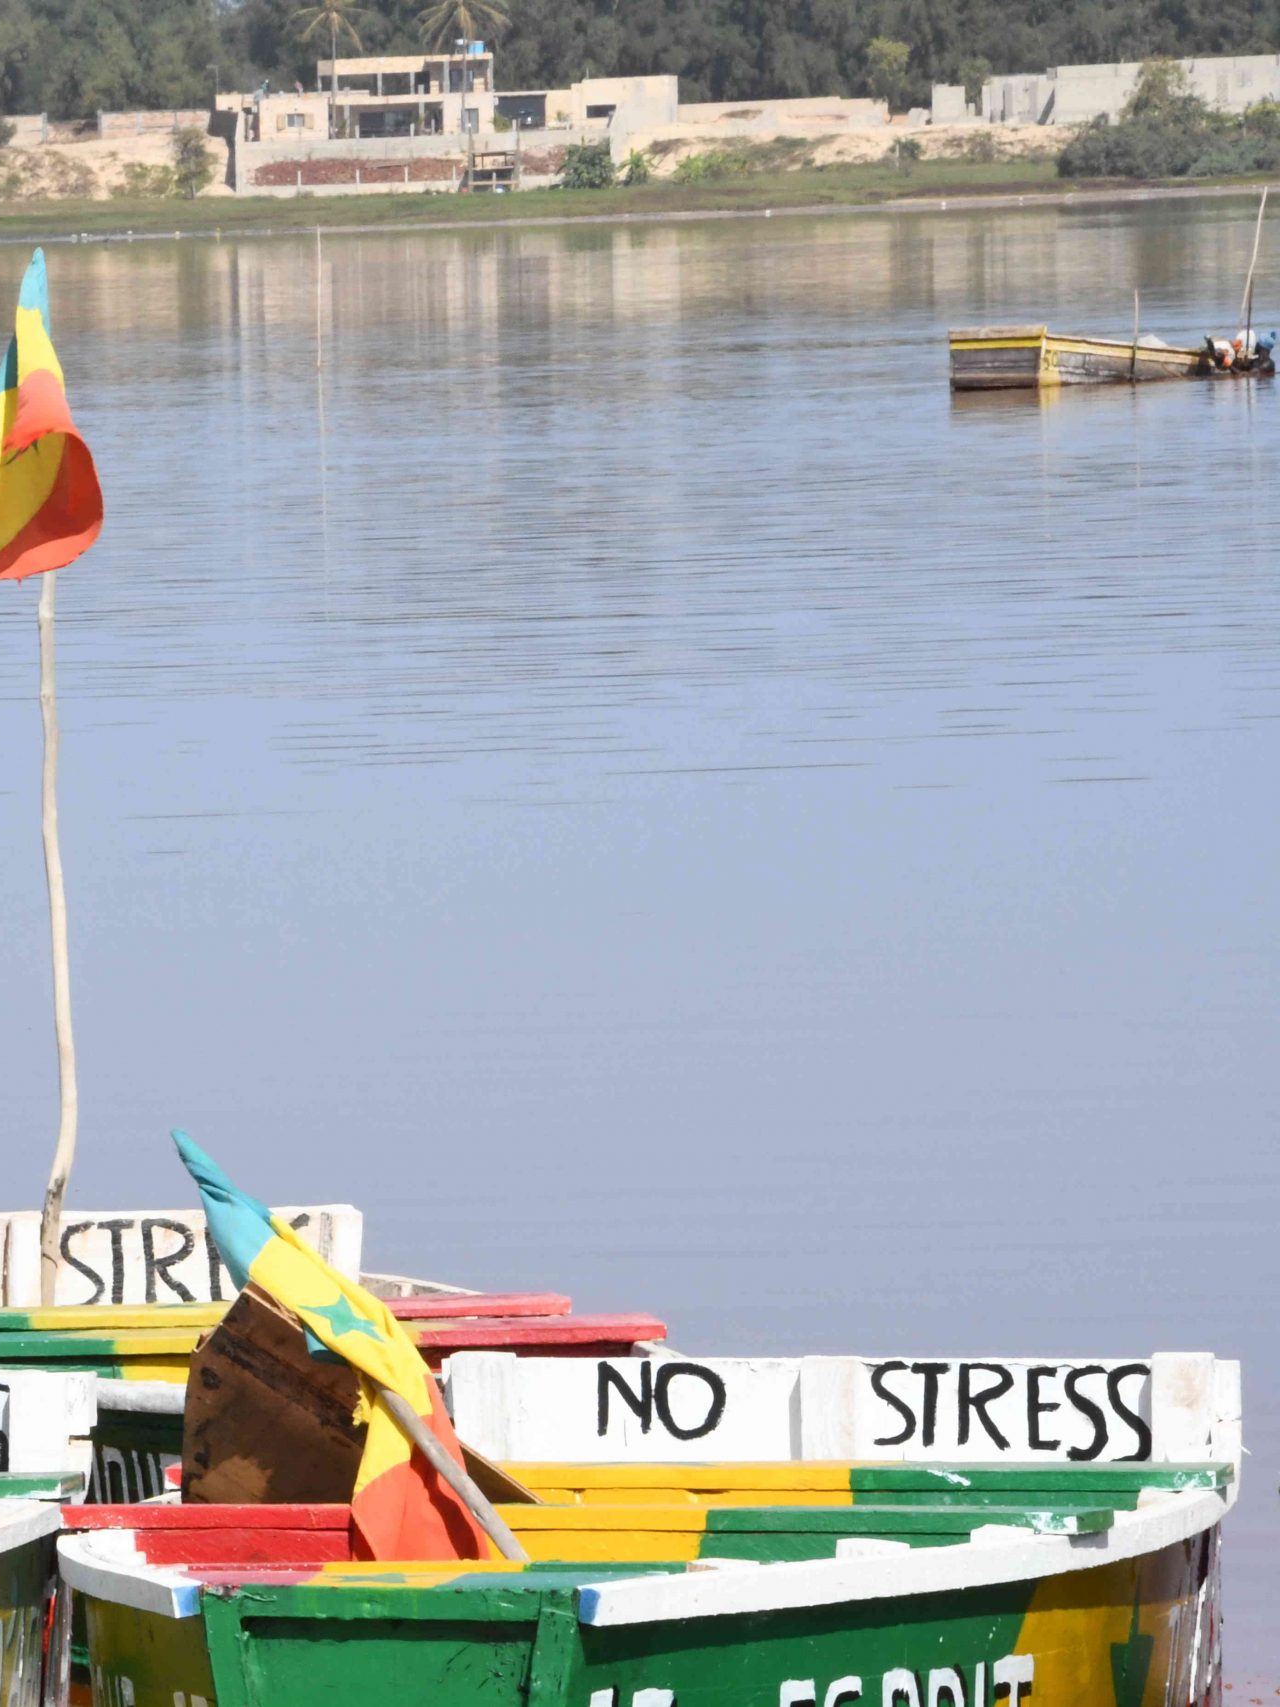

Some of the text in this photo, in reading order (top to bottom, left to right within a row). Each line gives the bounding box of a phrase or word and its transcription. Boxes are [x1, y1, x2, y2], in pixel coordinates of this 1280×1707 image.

[59, 1211, 310, 1306] STR
[595, 1360, 1153, 1463] NO STRESS
